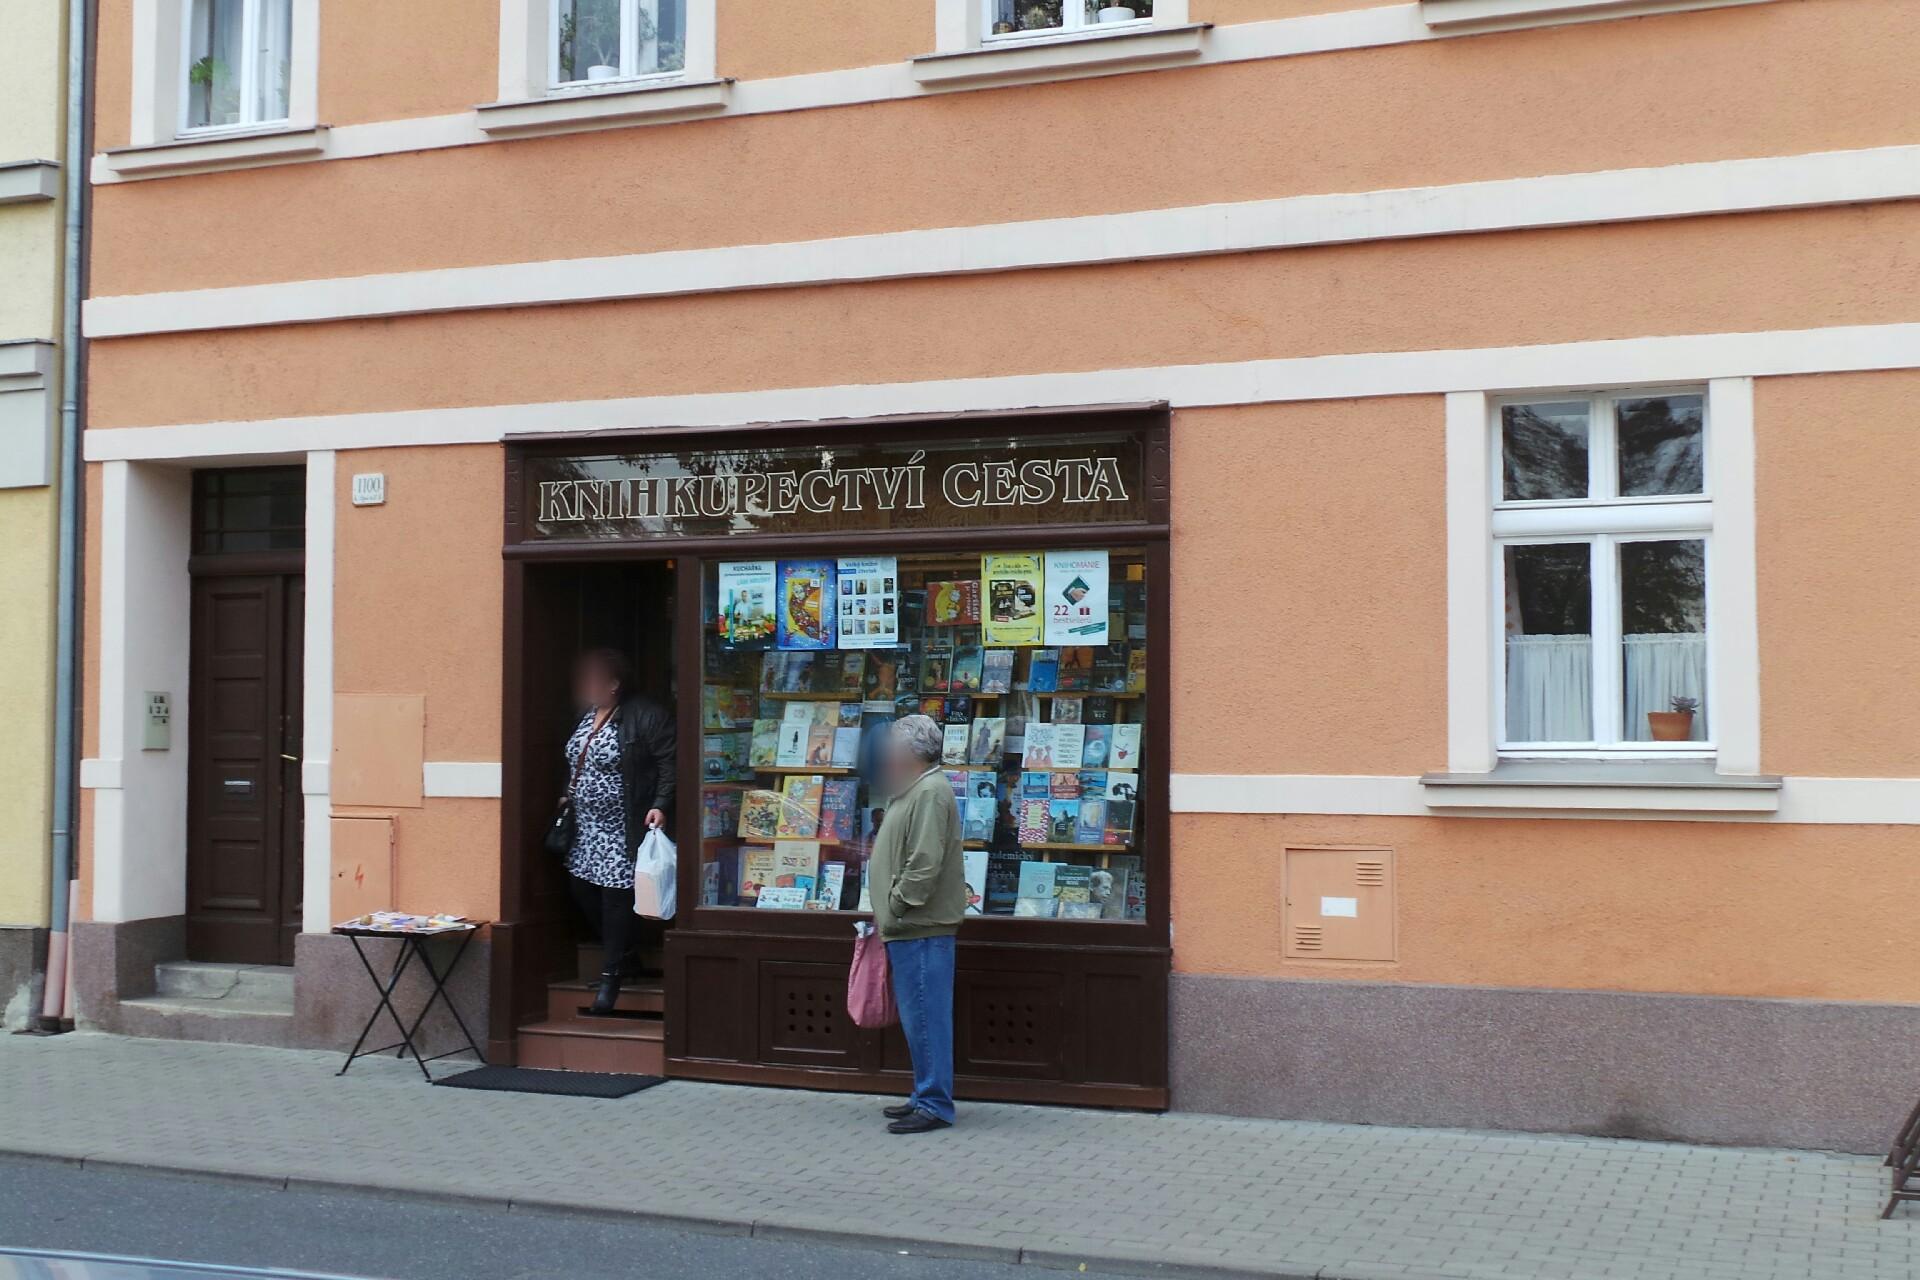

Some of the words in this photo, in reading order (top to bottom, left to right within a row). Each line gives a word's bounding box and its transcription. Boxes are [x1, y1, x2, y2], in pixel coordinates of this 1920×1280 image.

[357, 478, 381, 494] 1100
[539, 449, 925, 521] KNIHKUPECTVÍ
[942, 457, 1129, 508] CESTA
[1054, 560, 1101, 568] KNIHOMANIE
[1054, 605, 1069, 616] 22
